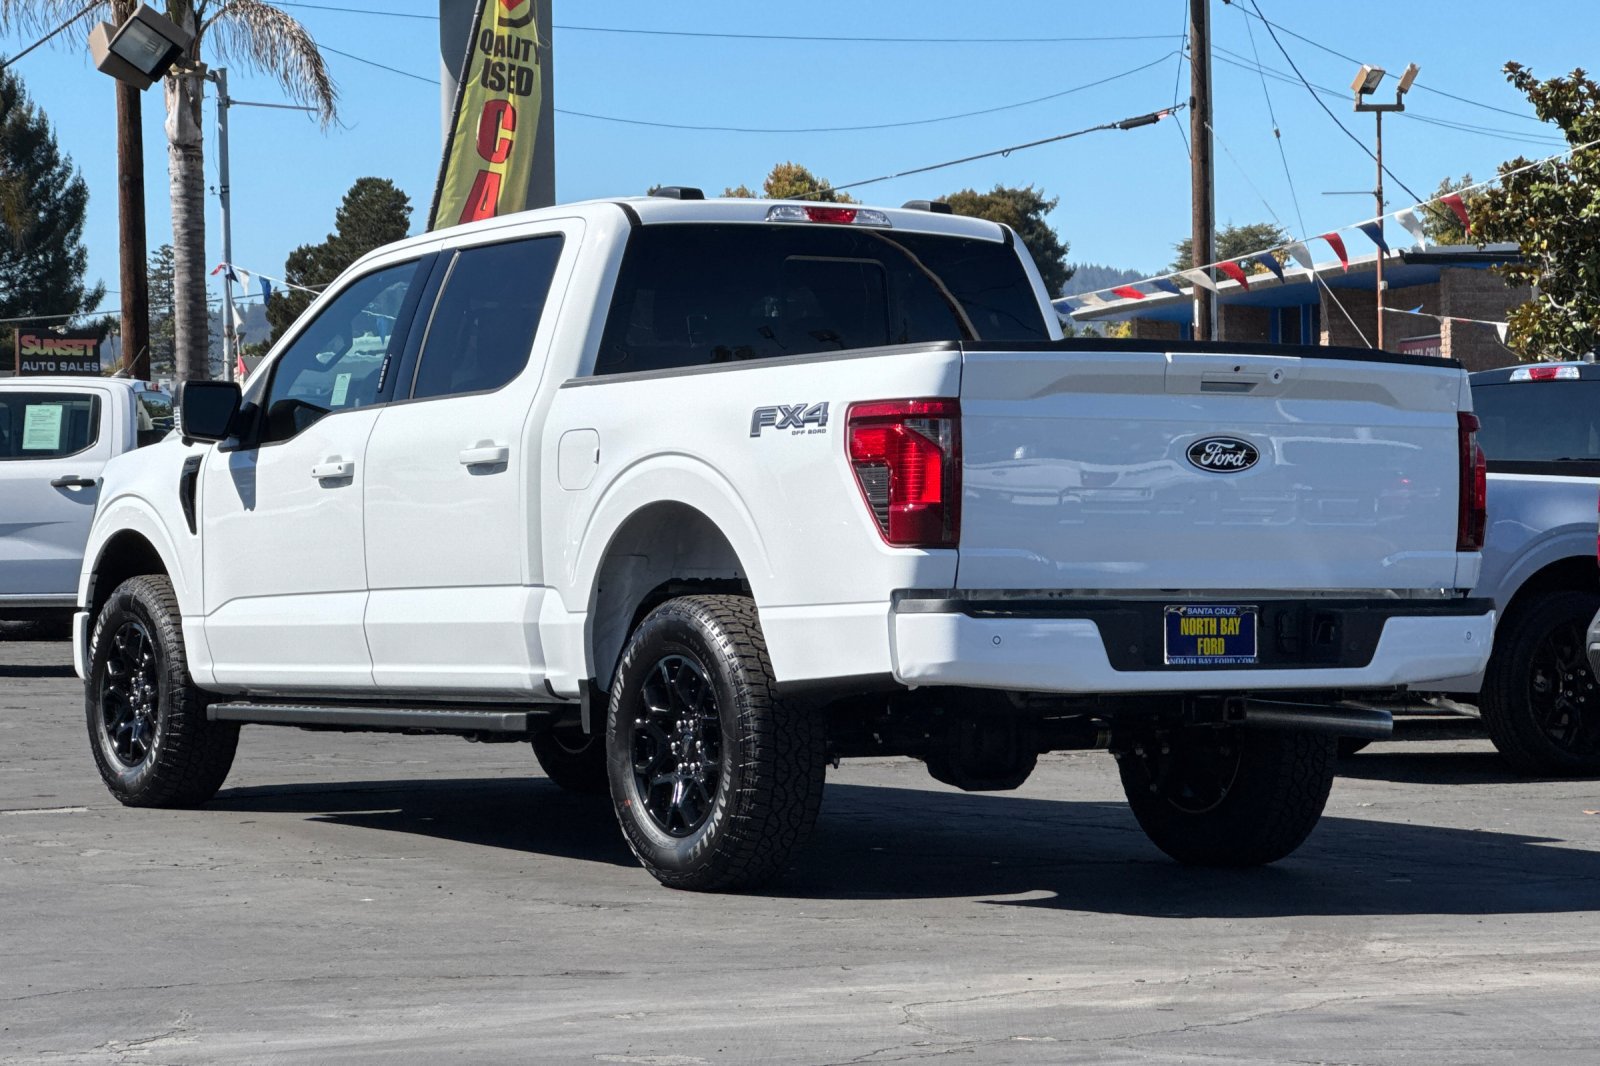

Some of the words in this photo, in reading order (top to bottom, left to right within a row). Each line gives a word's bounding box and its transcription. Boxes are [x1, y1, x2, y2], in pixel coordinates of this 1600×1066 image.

[1425, 346, 1442, 358] CRU
[21, 361, 56, 372] AUTO
[60, 361, 99, 372] SALES
[750, 401, 829, 438] FX4
[1200, 441, 1247, 466] Ford
[1187, 607, 1213, 615] SANTA
[1214, 607, 1237, 615] CRUZ
[1180, 617, 1217, 636] NORTH
[1220, 617, 1241, 636] BAY
[1197, 637, 1225, 656] FORD
